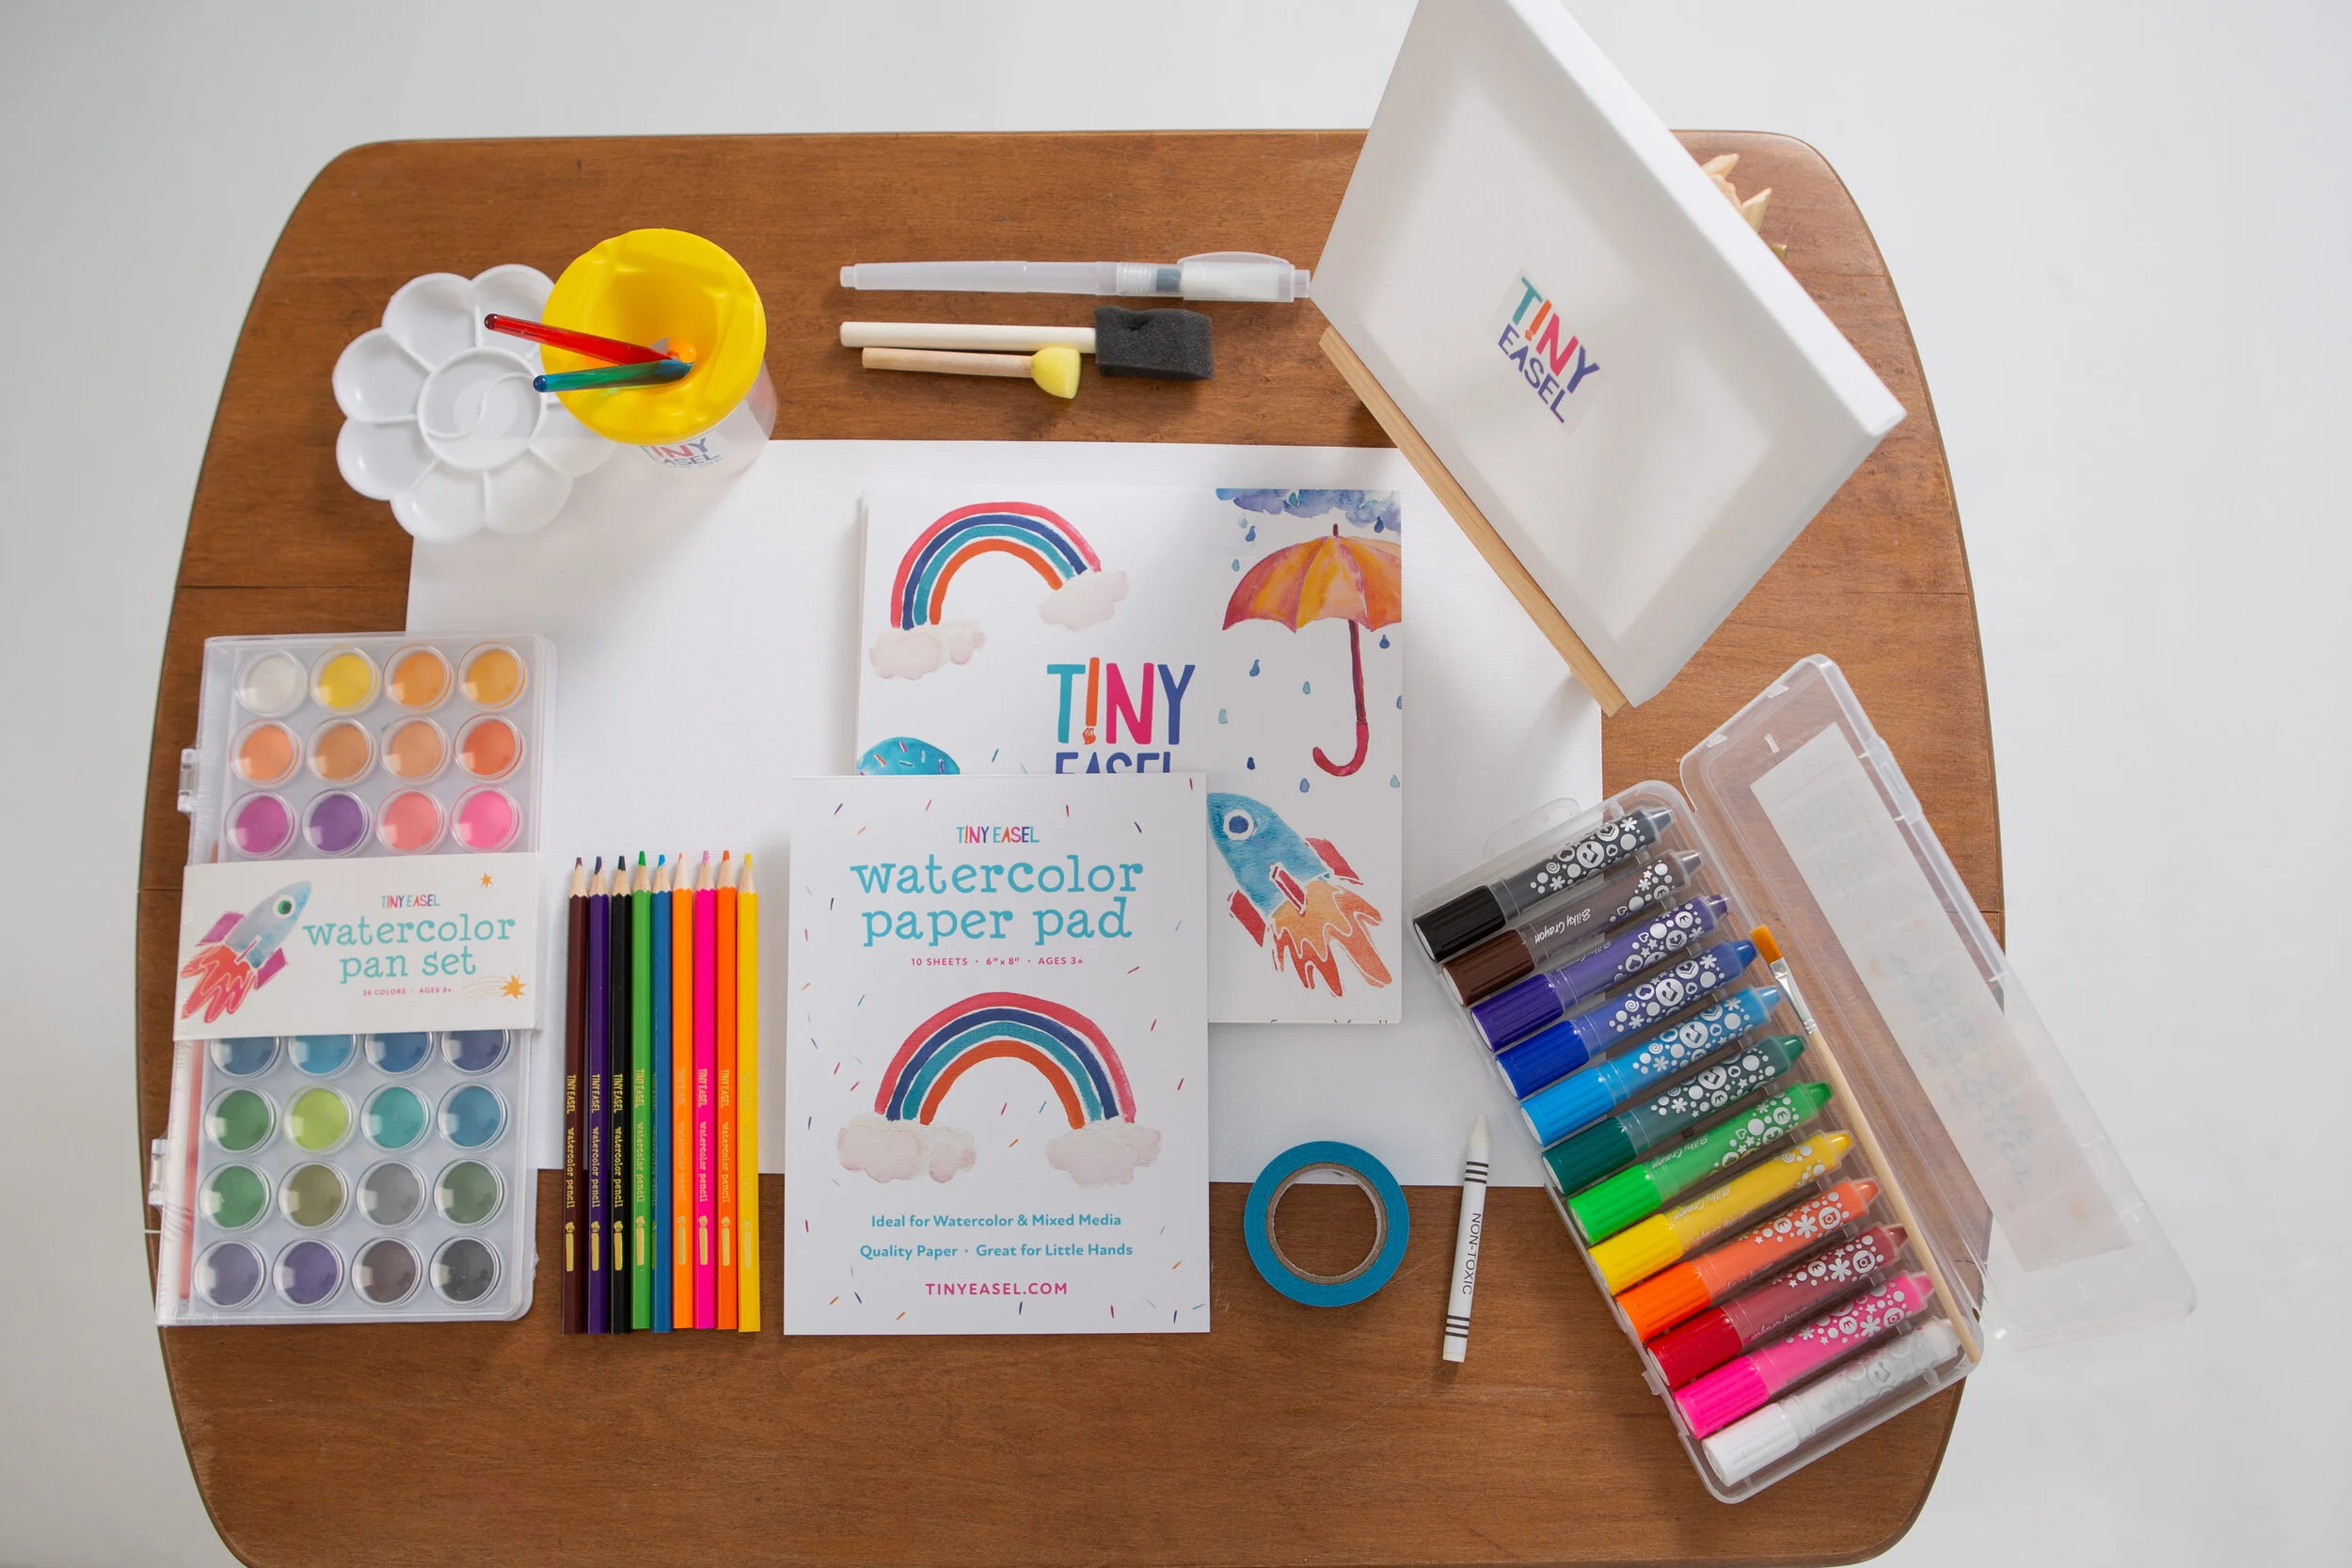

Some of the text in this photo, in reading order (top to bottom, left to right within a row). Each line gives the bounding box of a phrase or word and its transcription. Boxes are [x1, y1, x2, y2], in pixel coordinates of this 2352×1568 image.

[1512, 277, 1600, 394] TINY
[1498, 324, 1565, 423] EASEL
[651, 453, 722, 466] ASEL
[1047, 657, 1196, 745] TINY
[956, 825, 1040, 844] TINY EASEL
[850, 854, 1144, 895] watercolor
[382, 894, 440, 909] TINY EASEL
[302, 912, 516, 946] watercolor
[862, 896, 1133, 947] paper pad
[339, 944, 477, 985] pan set
[911, 958, 923, 967] 10
[926, 957, 968, 966] SHEETS
[1038, 956, 1067, 965] AGES
[1070, 956, 1084, 965] 3+
[374, 988, 406, 996] COLORS
[591, 1126, 600, 1208] watercolor pencil
[613, 1126, 623, 1208] watercolor pencil
[698, 1120, 707, 1202] watercolor pencil
[721, 1122, 730, 1203] watercolor pencil
[566, 1179, 575, 1209] pencil
[636, 1174, 644, 1202] pencil
[871, 1213, 1121, 1227] Ideal for Watercolor & Mixed Media
[860, 1243, 1134, 1261] Quality Paper Great for Little Hands
[1462, 1212, 1482, 1295] NON-TOXIC
[925, 1282, 1068, 1296] TINYEASEL.COM
